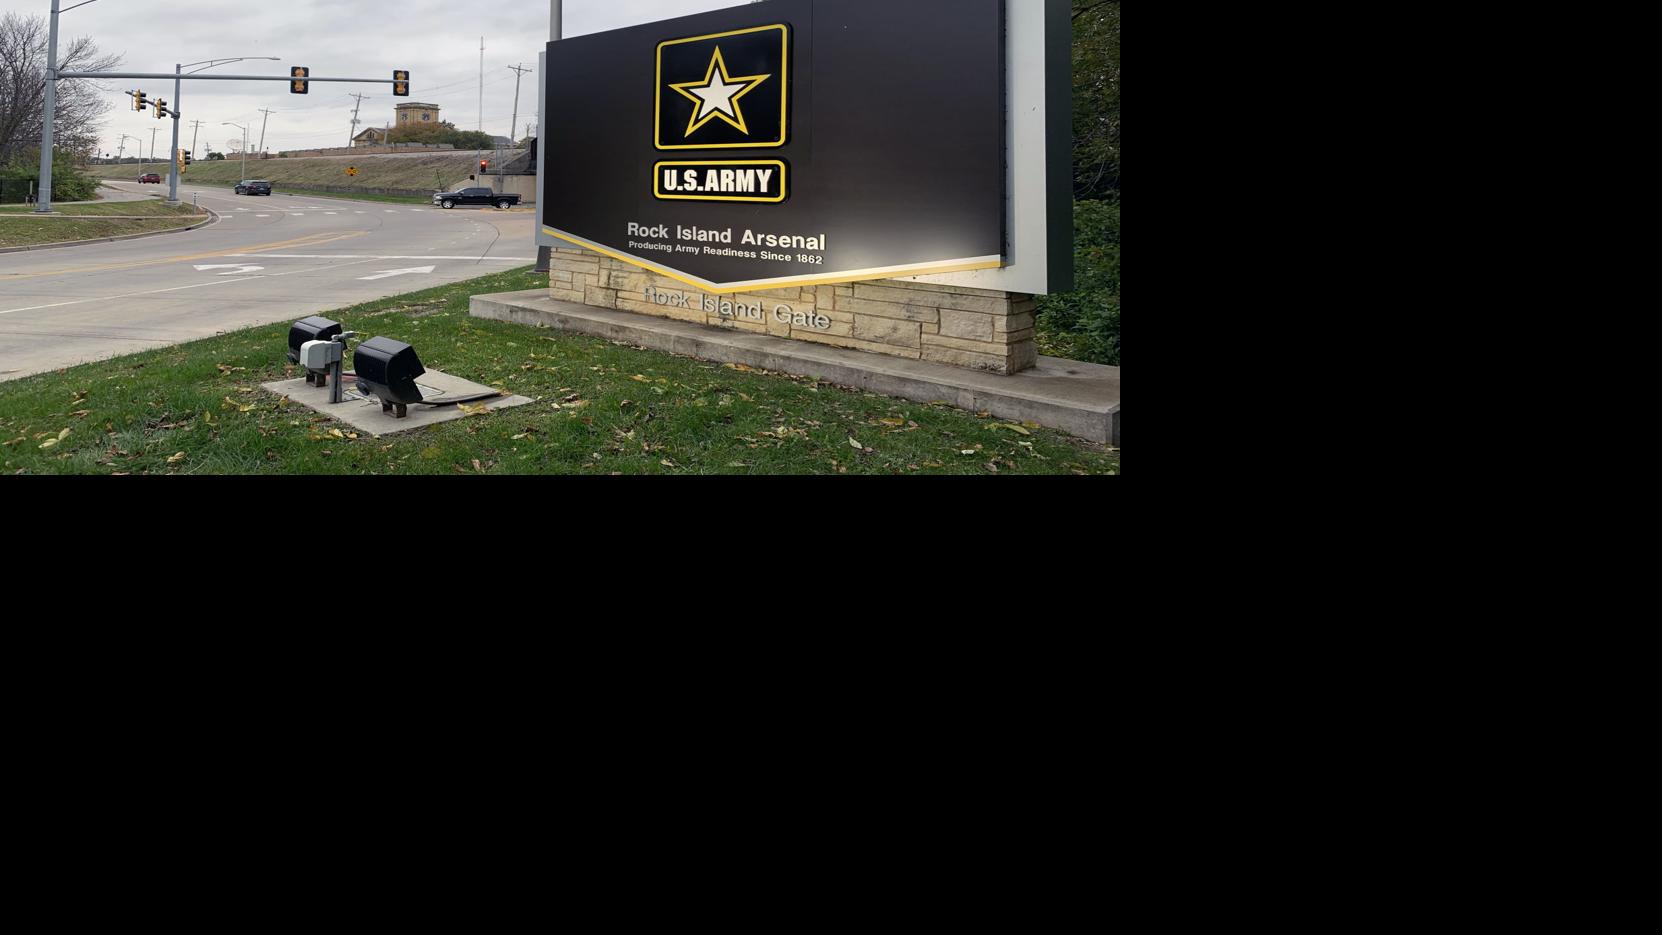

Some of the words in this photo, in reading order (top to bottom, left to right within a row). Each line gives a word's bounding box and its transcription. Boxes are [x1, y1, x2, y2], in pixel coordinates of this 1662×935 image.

[664, 169, 772, 193] U.S.ARMY
[627, 222, 669, 239] Rock
[676, 225, 732, 243] Island
[741, 229, 826, 251] Arsenal
[628, 241, 672, 253] Producing
[675, 244, 700, 255] Army
[703, 246, 757, 259] Readiness
[760, 251, 792, 262] Since
[796, 254, 823, 265] 1862
[644, 286, 691, 309] Rock
[701, 293, 764, 320] Island
[773, 303, 832, 330] Gate
